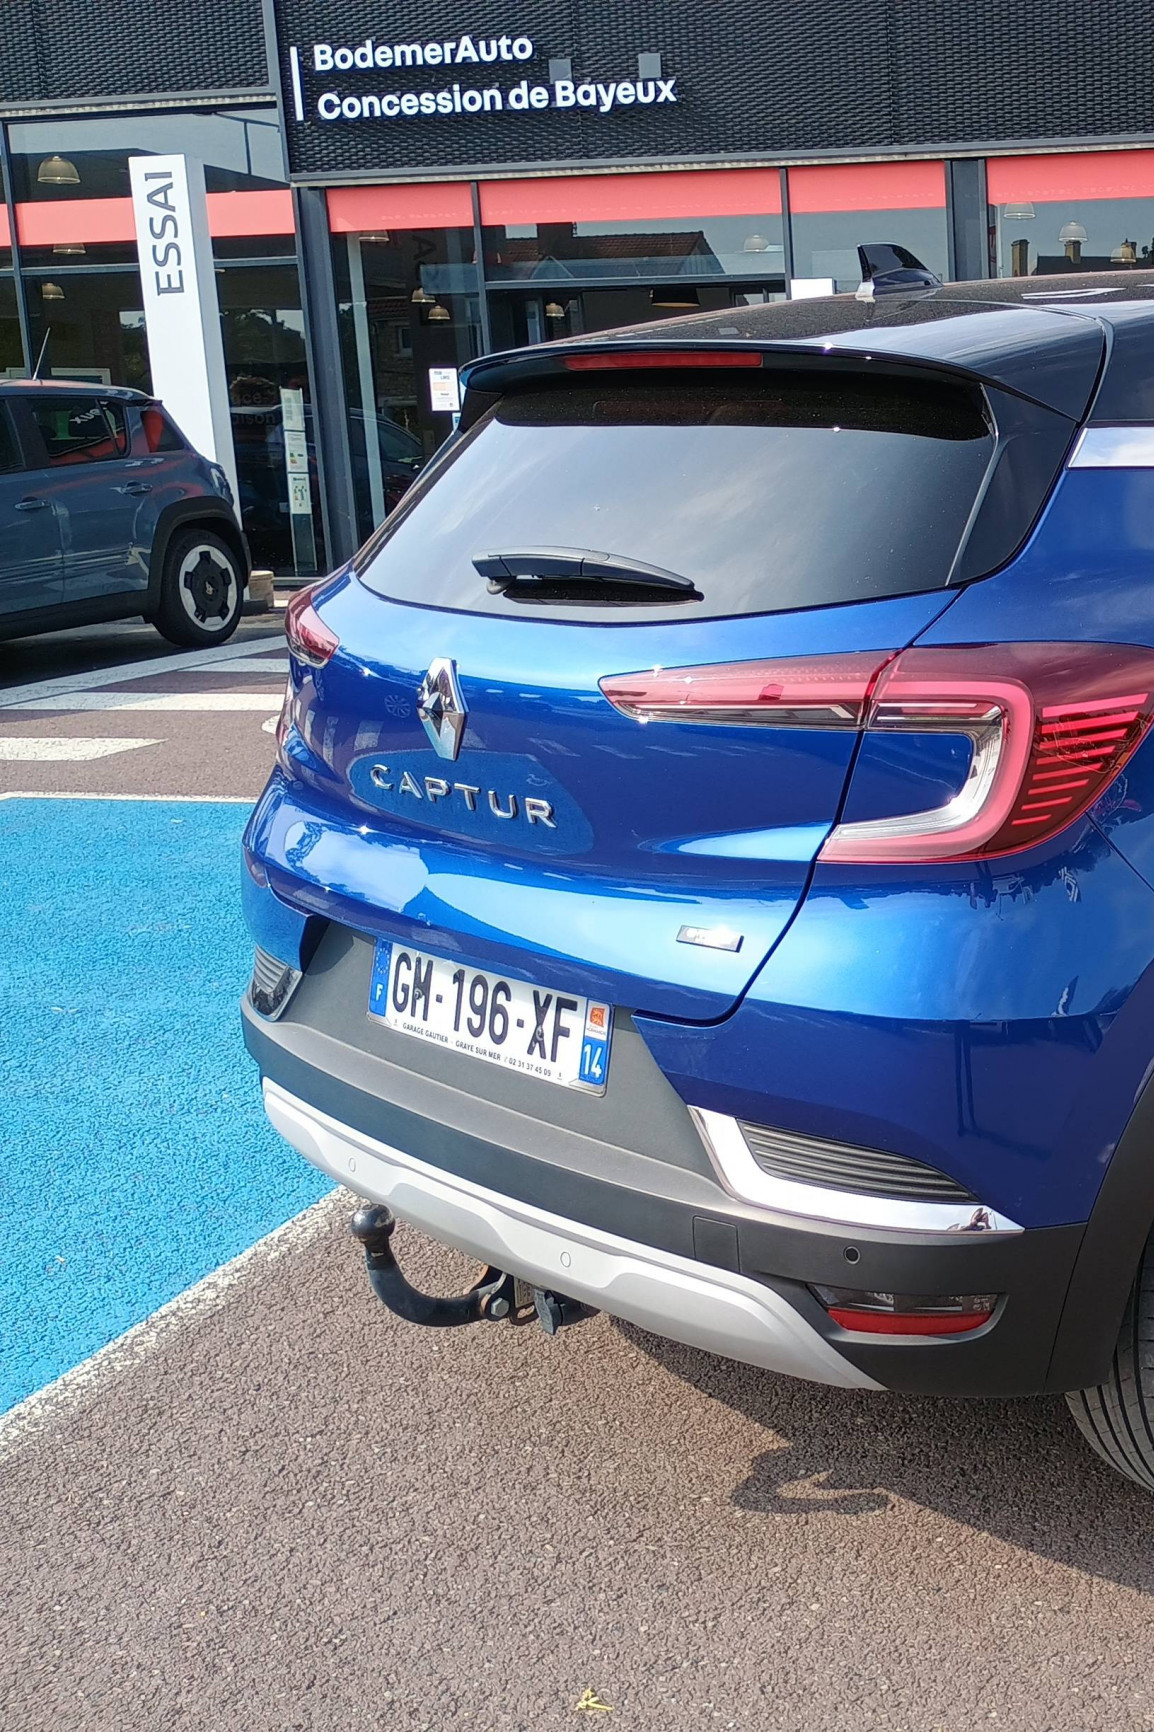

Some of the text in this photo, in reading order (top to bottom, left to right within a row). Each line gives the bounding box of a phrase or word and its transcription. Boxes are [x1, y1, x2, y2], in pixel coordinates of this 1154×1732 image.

[313, 35, 534, 71] BodemerAuto
[317, 78, 678, 120] Concession de Bayeux
[144, 171, 185, 296] ESSAI
[369, 763, 558, 829] CAPTUR
[375, 983, 384, 1001] F
[402, 1022, 424, 1035] GARAGE
[425, 1030, 449, 1043] GAUTIER
[455, 1040, 474, 1052] GRAYE
[475, 1047, 488, 1056] SUR
[488, 1051, 501, 1060] MER
[508, 1057, 517, 1066] 02
[517, 1060, 525, 1068] 31
[526, 1062, 534, 1070] 37
[534, 1065, 543, 1074] 45
[543, 1068, 552, 1077] 09
[583, 1044, 602, 1079] 14
